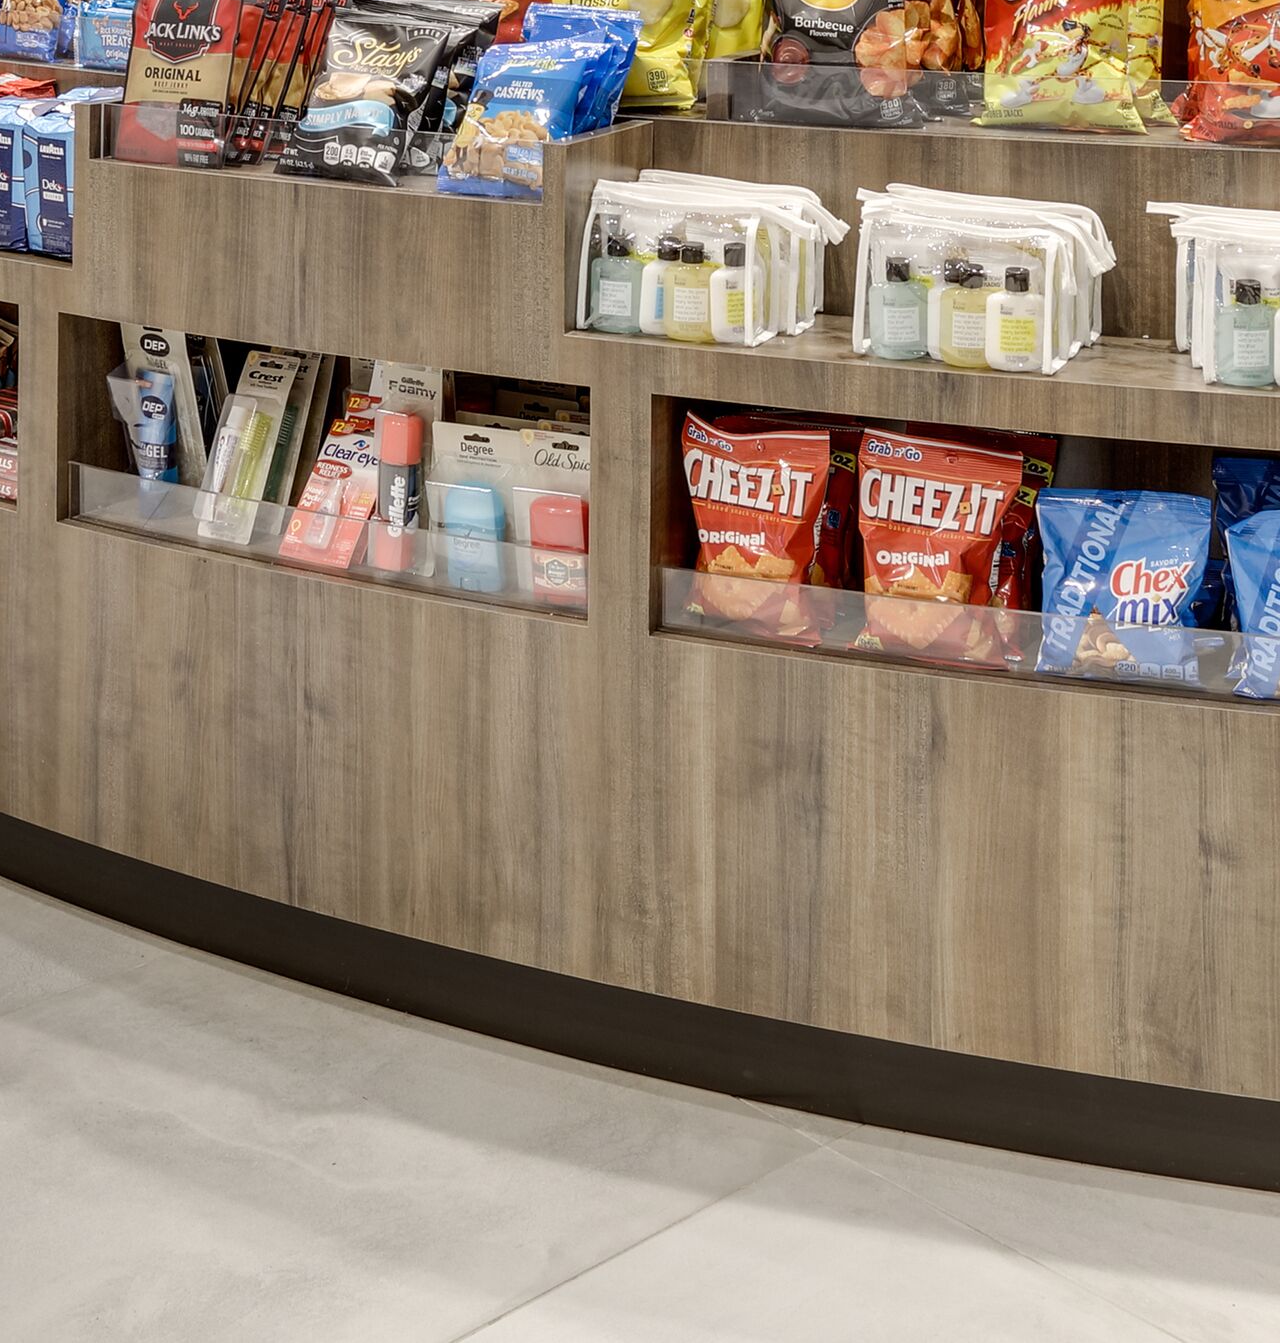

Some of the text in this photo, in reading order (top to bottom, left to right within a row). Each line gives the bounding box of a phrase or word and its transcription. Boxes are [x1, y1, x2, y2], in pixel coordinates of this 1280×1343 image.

[794, 16, 854, 33] Barbecue
[176, 22, 221, 42] LINK'S
[413, 26, 441, 38] BAKED
[809, 30, 838, 38] Flavored
[334, 37, 423, 77] Stacy's
[144, 67, 202, 82] ORIGINAL
[649, 68, 666, 81] 390
[494, 85, 545, 101] CASHEWS
[305, 111, 342, 126] SIMPLY
[179, 124, 195, 136] 100
[39, 143, 65, 156] LAVAZZA
[326, 145, 338, 155] 200
[144, 339, 167, 351] DEP
[153, 359, 169, 369] GEL
[248, 370, 284, 383] Crest
[401, 377, 424, 386] Gillette
[389, 380, 437, 400] Foamy
[142, 401, 163, 413] DEP
[349, 397, 361, 408] 12
[332, 422, 345, 432] 12
[687, 424, 733, 453] Grab Go
[146, 444, 168, 458] GEL
[324, 443, 378, 468] Clear eye
[460, 442, 494, 456] Degree
[867, 440, 923, 461] Grab Go
[534, 449, 590, 472] Old Spic
[317, 463, 349, 474] REDNESS
[387, 475, 405, 537] Gillette
[707, 504, 727, 514] baked
[730, 507, 749, 517] snack
[888, 523, 910, 532] baked
[1149, 555, 1180, 568] SAVORY
[1046, 500, 1124, 651] TRADITIONAL
[1111, 559, 1196, 598] Chex
[1118, 592, 1184, 627] mix
[1118, 663, 1137, 673] 220
